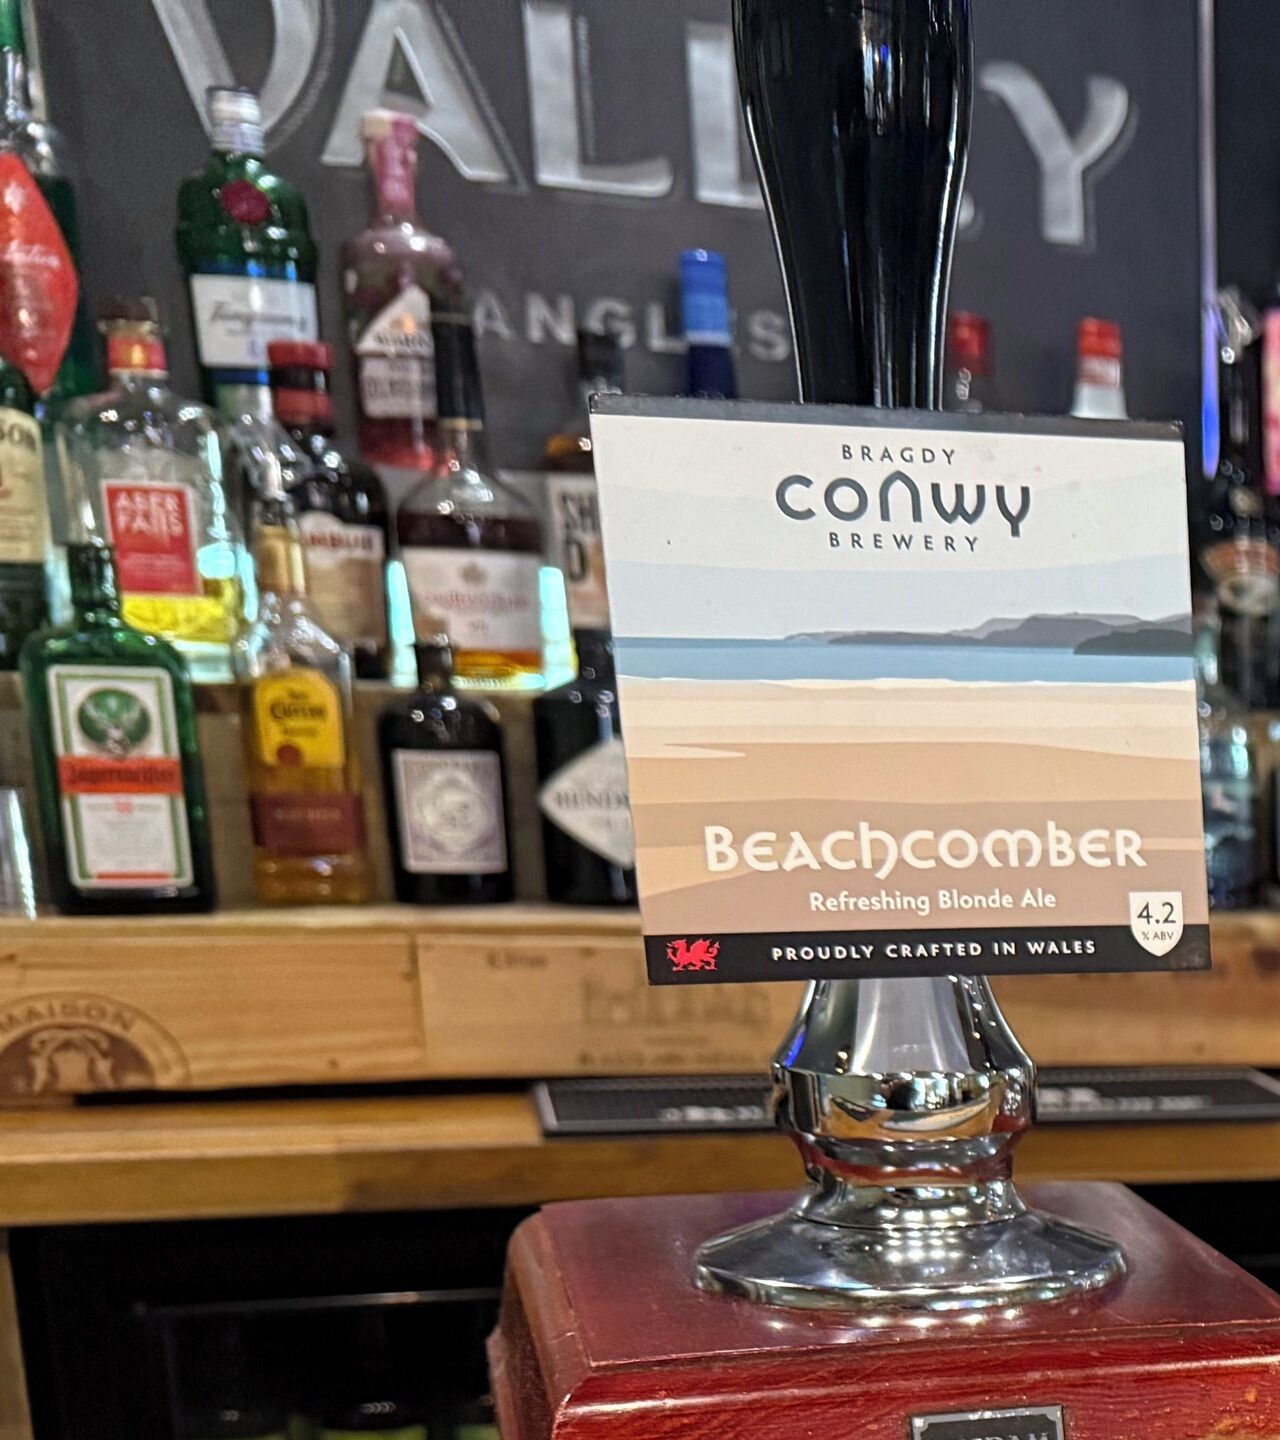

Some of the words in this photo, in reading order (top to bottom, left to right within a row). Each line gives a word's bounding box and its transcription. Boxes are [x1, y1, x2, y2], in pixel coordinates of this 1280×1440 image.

[842, 444, 957, 466] BRAGDY
[114, 490, 180, 513] ABER
[775, 470, 1031, 537] CONWY
[829, 532, 979, 553] BREWERY
[810, 891, 930, 916] Refreshing
[938, 889, 1013, 910] Blonde
[1021, 890, 1056, 909] Ale
[1137, 901, 1176, 925] 4.2
[1153, 931, 1174, 941] ABV
[772, 945, 875, 962] PROUDLY
[885, 942, 982, 959] CRAFTED
[993, 942, 1017, 956] IN
[1027, 940, 1096, 956] WALES
